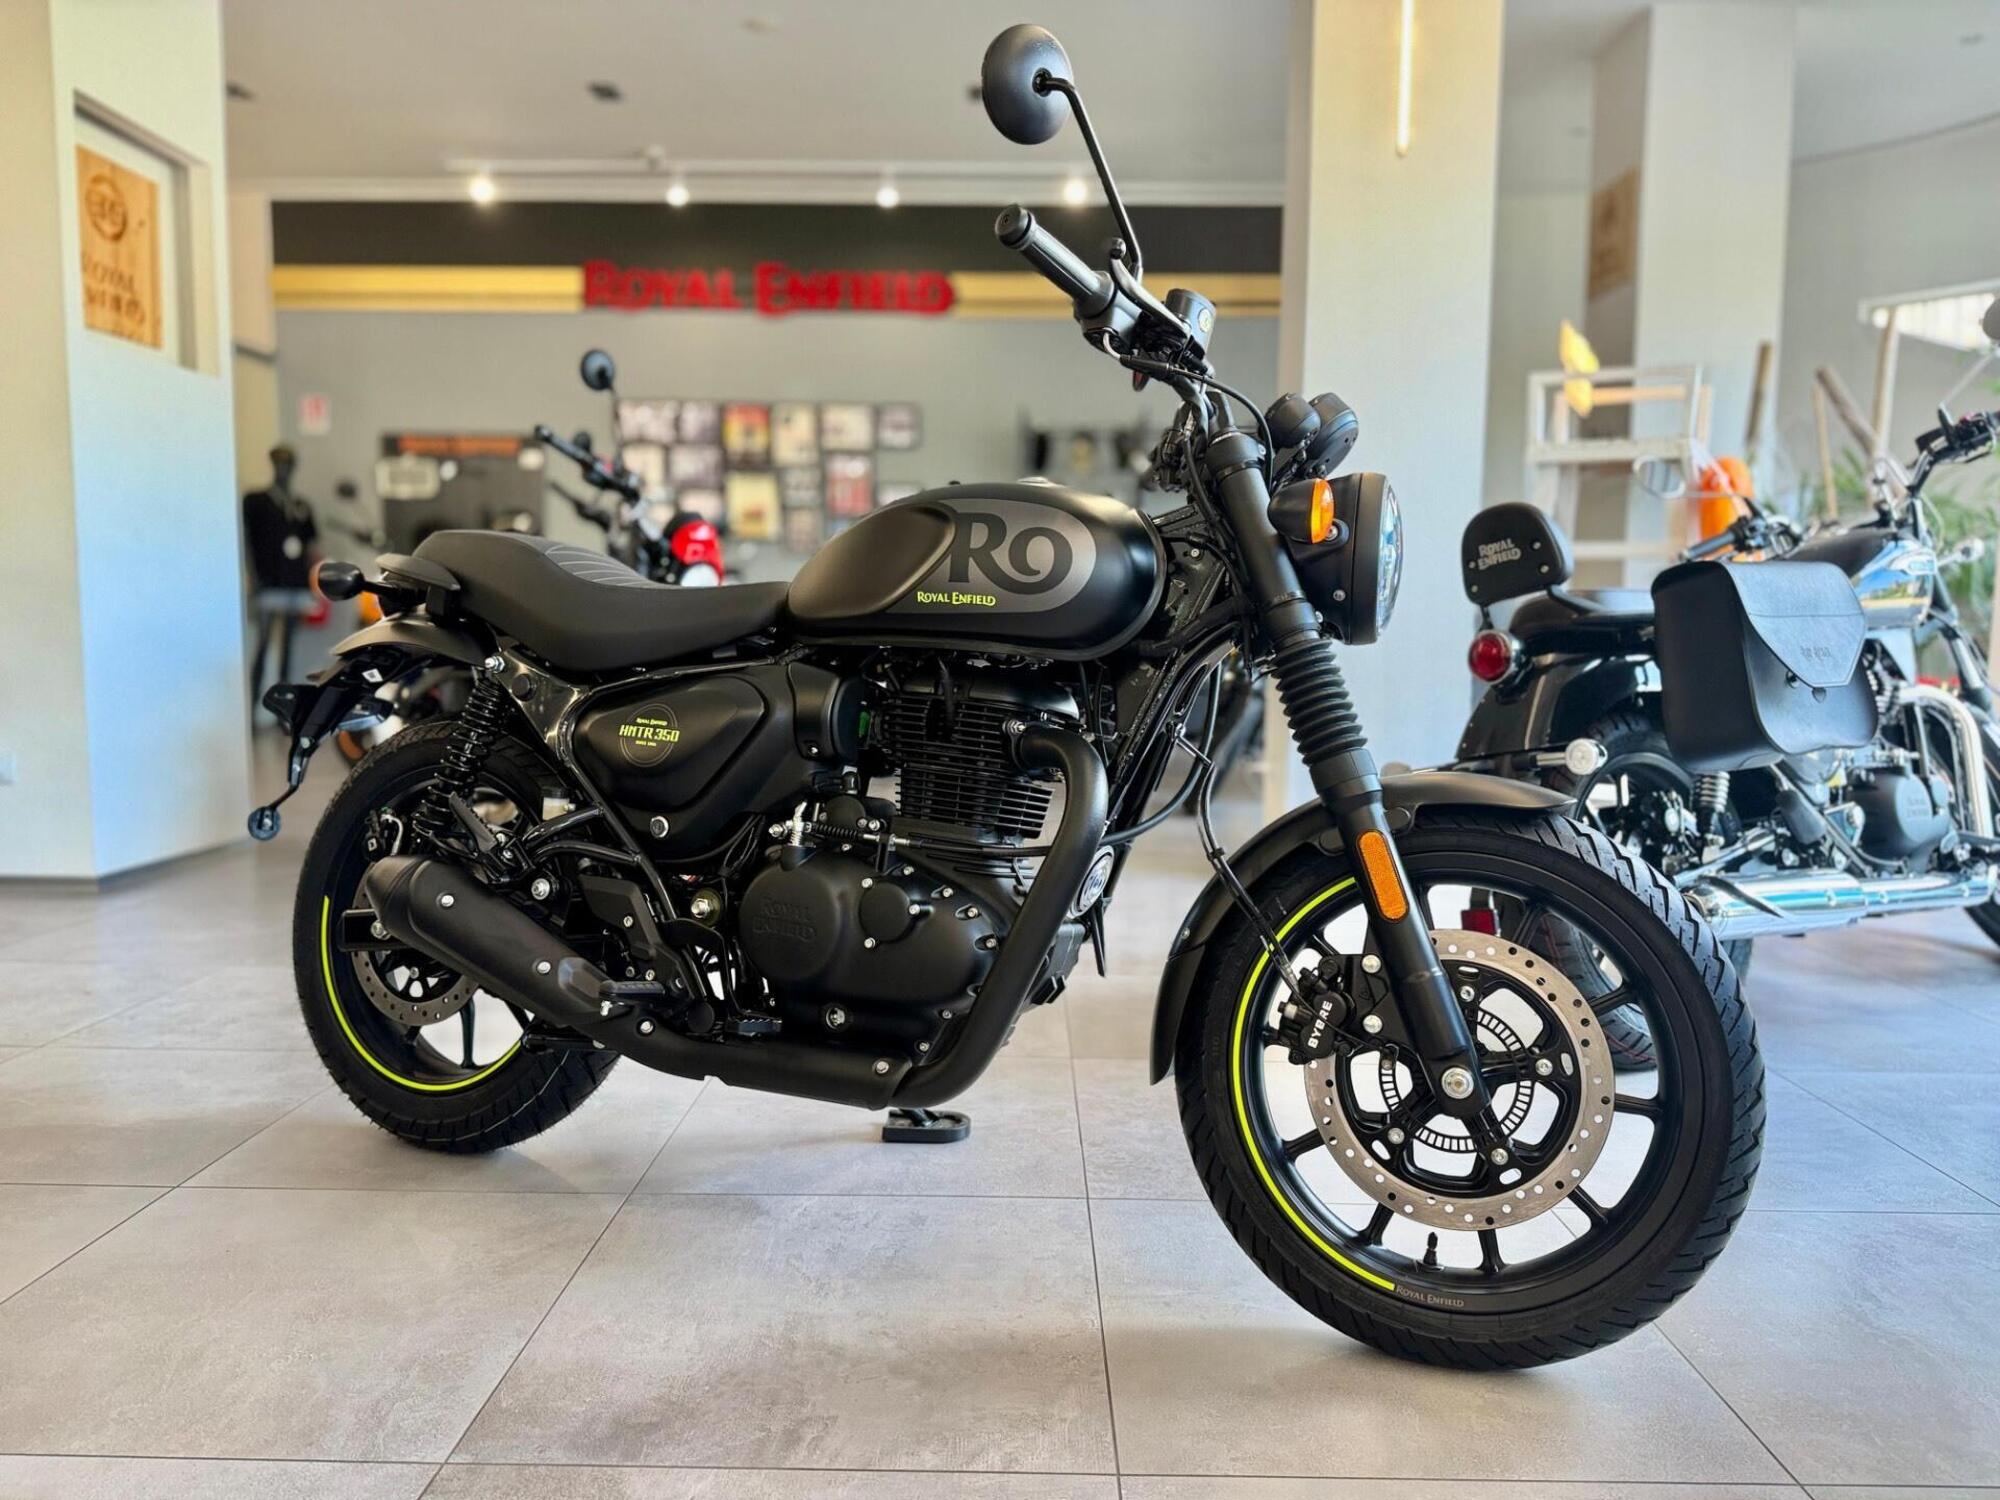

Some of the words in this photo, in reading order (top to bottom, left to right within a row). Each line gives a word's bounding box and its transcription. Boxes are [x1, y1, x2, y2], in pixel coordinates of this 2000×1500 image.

[584, 259, 741, 316] ROYAL
[753, 260, 955, 318] ENFIELD
[1477, 547, 1522, 570] ENFIELD
[1478, 538, 1516, 557] ROYAL
[917, 591, 950, 604] ROYAL
[951, 592, 996, 606] ENFIELD
[654, 728, 680, 742] 350
[1308, 1000, 1333, 1049] BYBRE
[1396, 1285, 1426, 1300] ROYAL
[1427, 1294, 1465, 1308] ENFIELD
